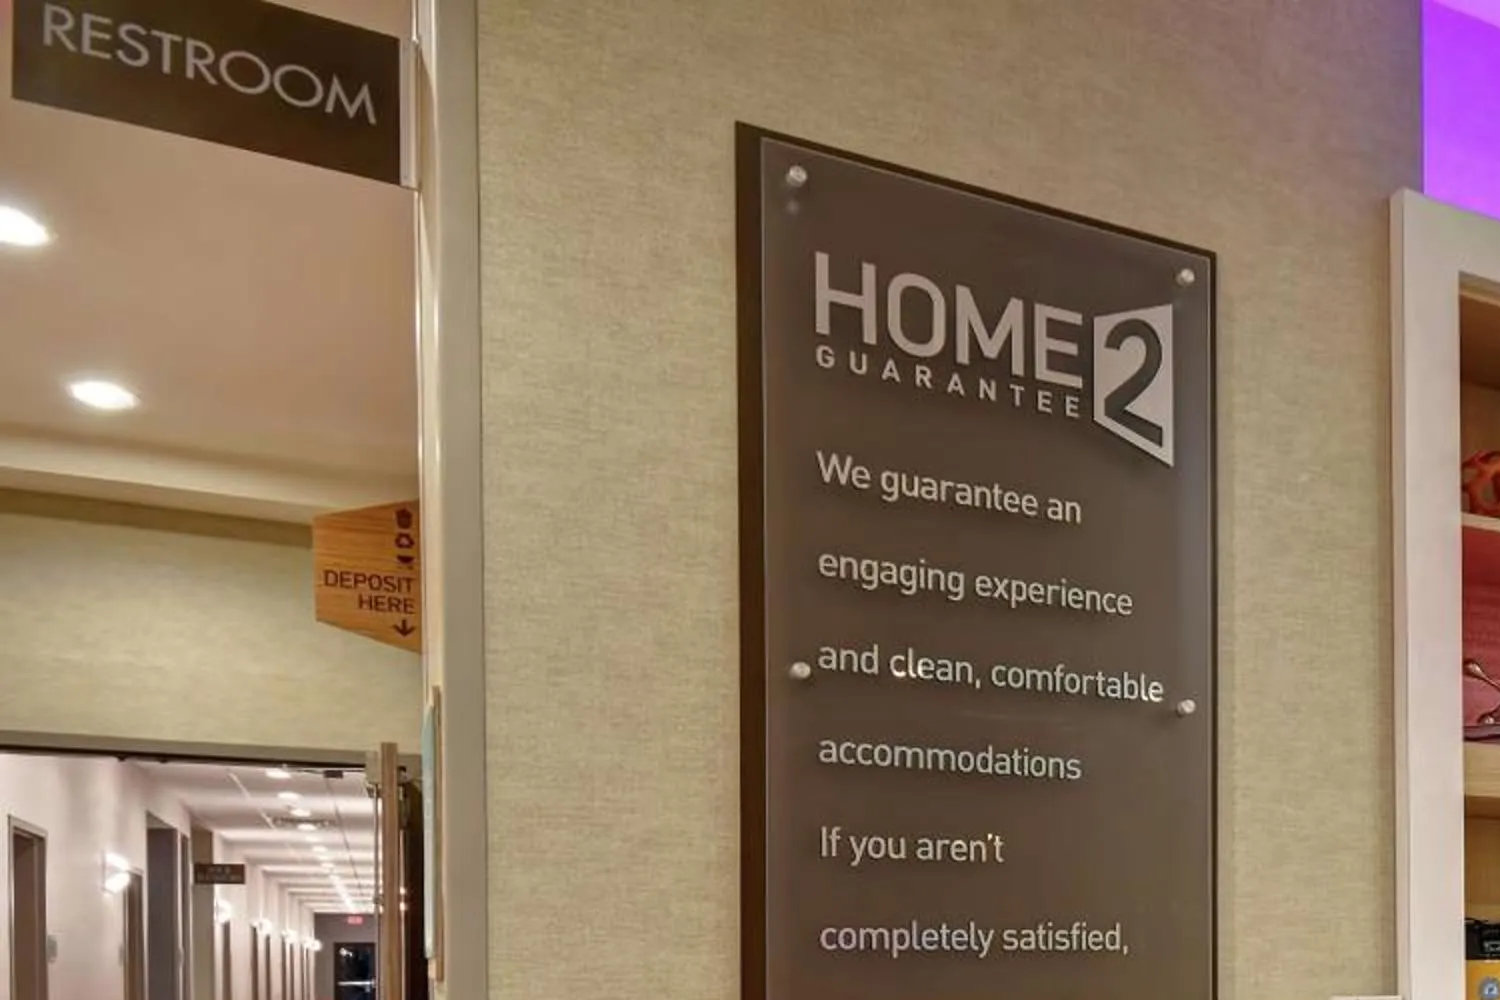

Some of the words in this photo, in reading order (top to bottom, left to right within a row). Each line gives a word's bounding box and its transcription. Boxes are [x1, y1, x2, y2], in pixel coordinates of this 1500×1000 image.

[42, 3, 377, 126] RESTROOM
[816, 345, 1080, 418] GUARANTEE
[816, 450, 871, 489] We
[880, 469, 1038, 516] guarantee
[1047, 499, 1082, 523] an
[324, 570, 414, 593] DEPOSIT
[358, 594, 415, 615] HERE
[818, 553, 965, 600] engaging
[974, 574, 1133, 615] experience
[818, 643, 879, 675] and
[889, 647, 981, 689] clean,
[991, 660, 1164, 703] comfortable
[819, 738, 1082, 780] accommodations
[821, 826, 840, 857] If
[849, 835, 907, 867] you
[916, 832, 1004, 863] aren't
[820, 920, 994, 959] completely
[1003, 921, 1129, 956] satisfied,
